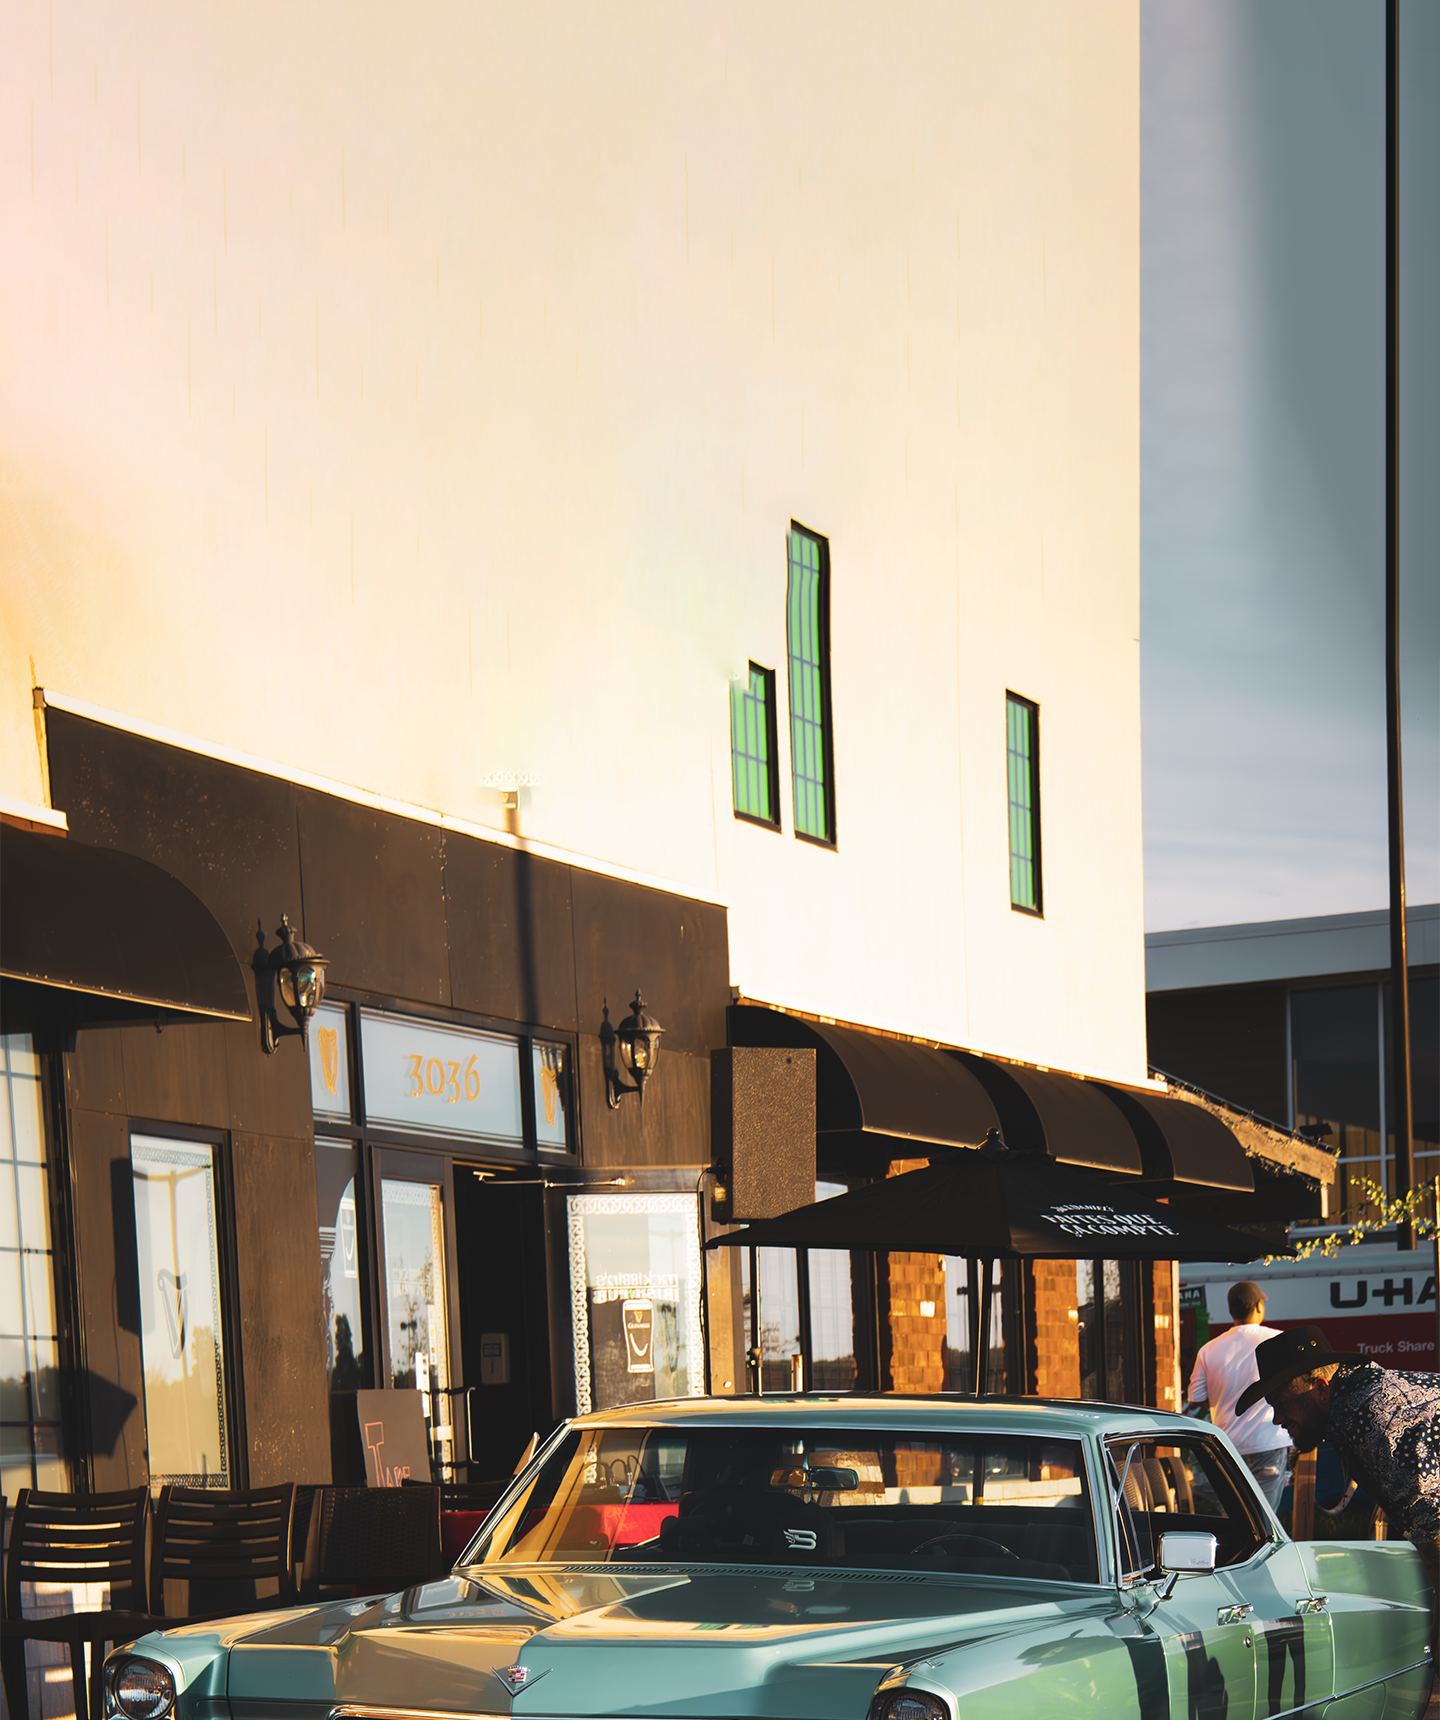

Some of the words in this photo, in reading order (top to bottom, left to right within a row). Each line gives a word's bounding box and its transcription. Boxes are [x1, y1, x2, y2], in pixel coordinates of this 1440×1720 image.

[409, 1053, 480, 1103] 3036
[1040, 1214, 1117, 1225] FAITES
[1113, 1214, 1161, 1225] QUE
[1060, 1224, 1093, 1237] ÇA
[1087, 1224, 1179, 1236] COMPTE
[1357, 1342, 1394, 1354] Truck
[1397, 1340, 1435, 1352] Share
